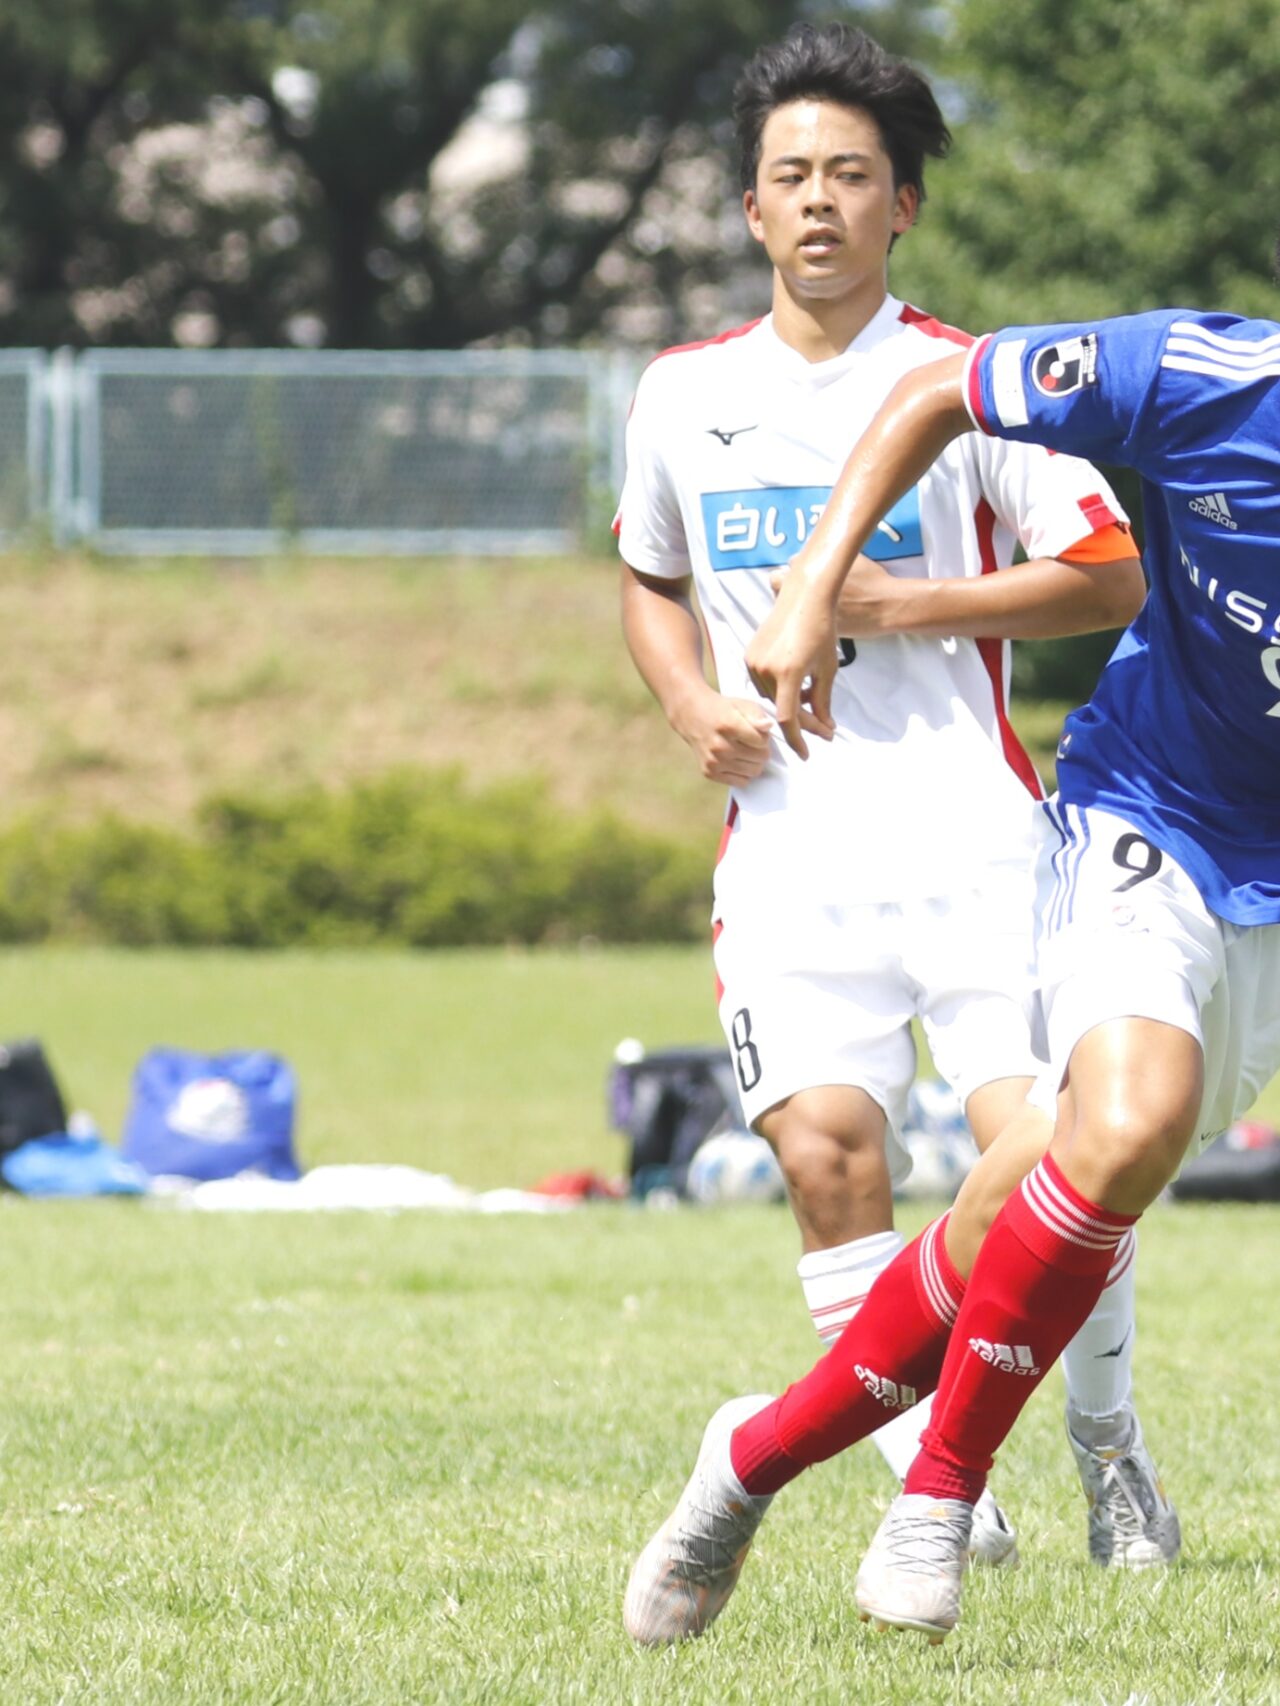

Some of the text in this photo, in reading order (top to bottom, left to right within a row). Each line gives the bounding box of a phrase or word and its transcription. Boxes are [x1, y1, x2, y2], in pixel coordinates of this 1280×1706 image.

[716, 502, 903, 552] 白い
[1188, 500, 1238, 531] adidas
[1112, 832, 1163, 893] 9
[731, 1007, 763, 1093] 8
[968, 1337, 1041, 1376] adidas
